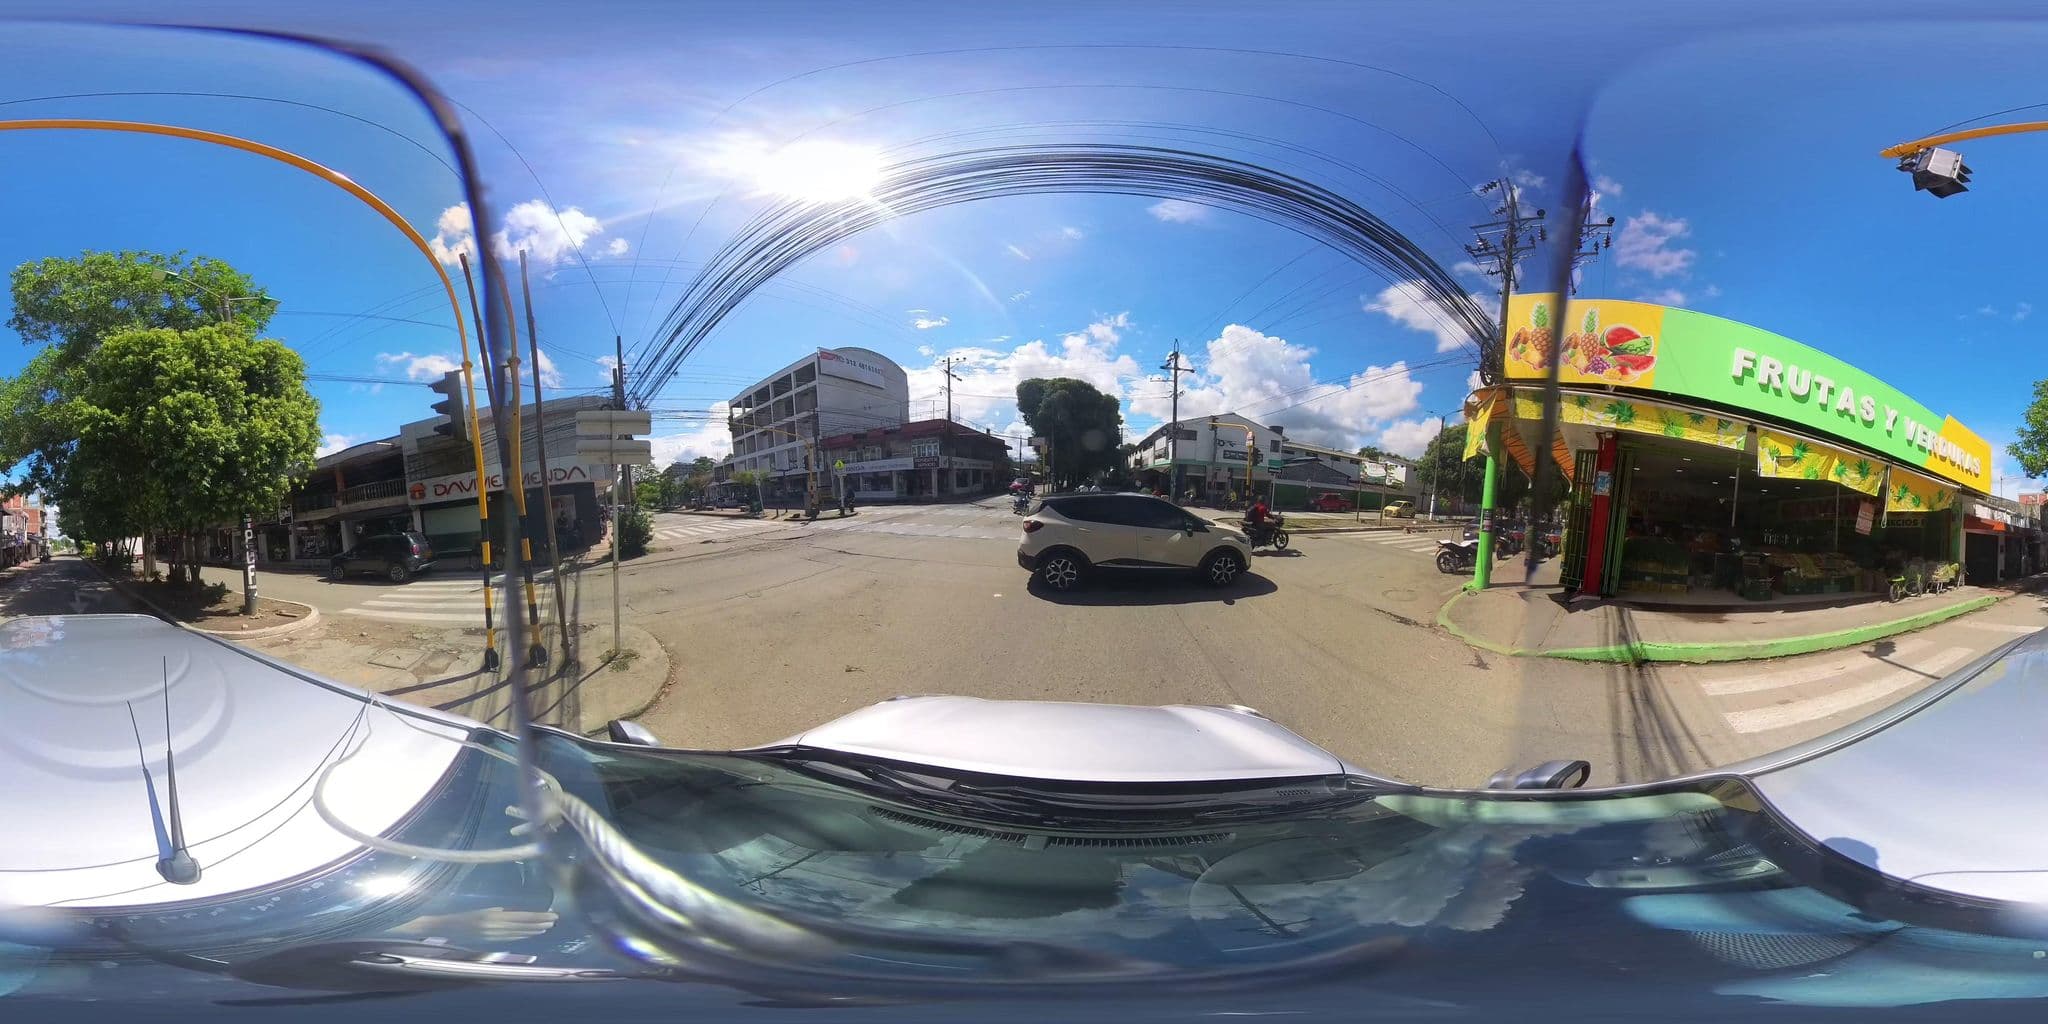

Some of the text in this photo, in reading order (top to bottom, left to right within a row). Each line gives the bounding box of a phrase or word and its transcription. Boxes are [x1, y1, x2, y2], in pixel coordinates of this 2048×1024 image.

[1731, 347, 1982, 475] FRUTAS Y VERDURAS
